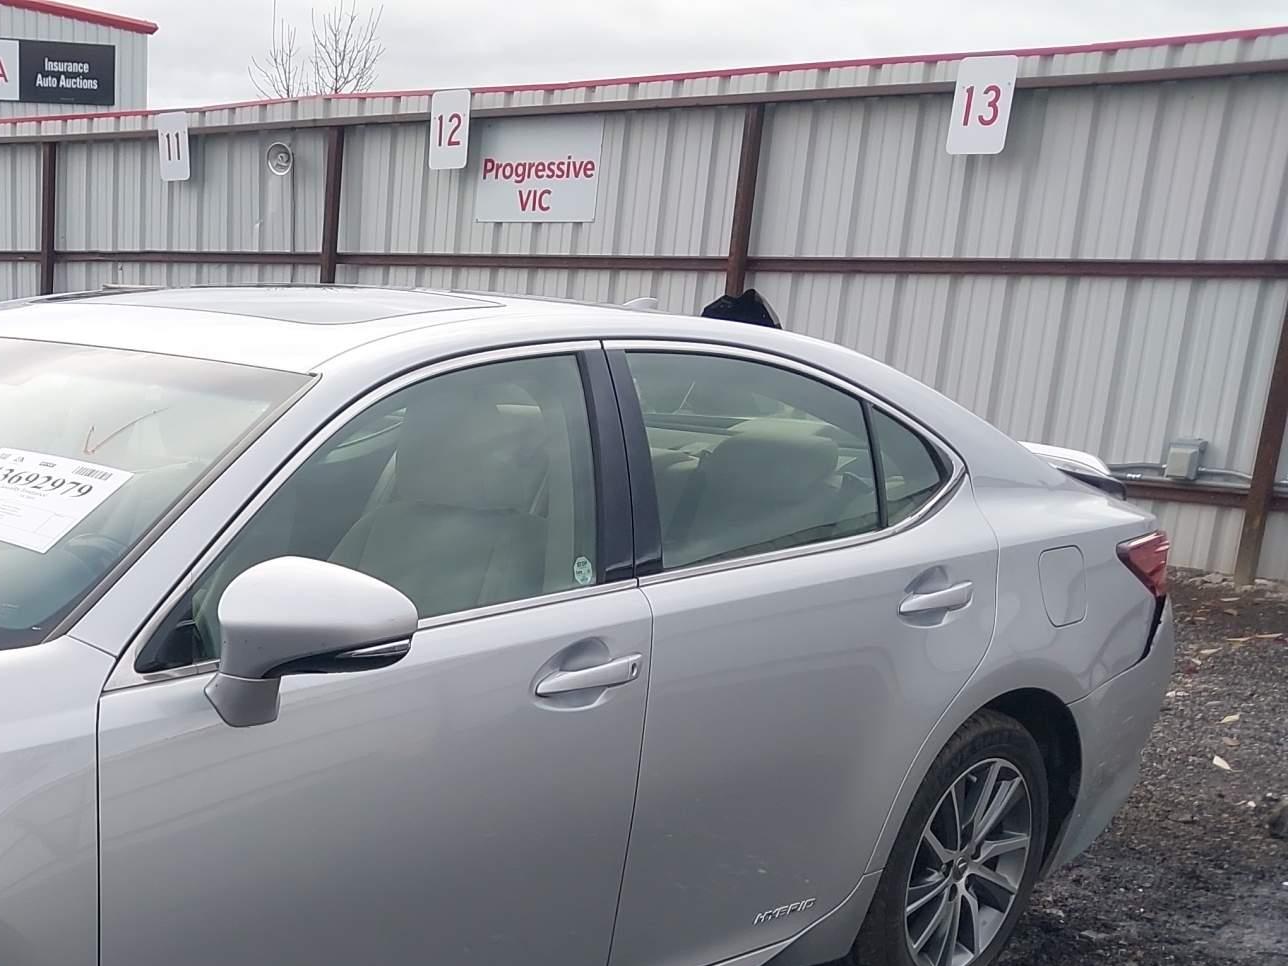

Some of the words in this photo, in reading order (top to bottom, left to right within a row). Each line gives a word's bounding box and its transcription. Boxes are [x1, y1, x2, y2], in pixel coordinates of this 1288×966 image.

[44, 57, 89, 73] Insurance
[35, 73, 57, 88] Auto
[59, 74, 98, 90] Auctions
[962, 85, 1001, 127] 13
[437, 113, 462, 147] 12
[165, 132, 181, 161] 11
[482, 155, 595, 184] Progressive
[518, 189, 552, 212] VIC
[754, 898, 816, 925] HYBRID
